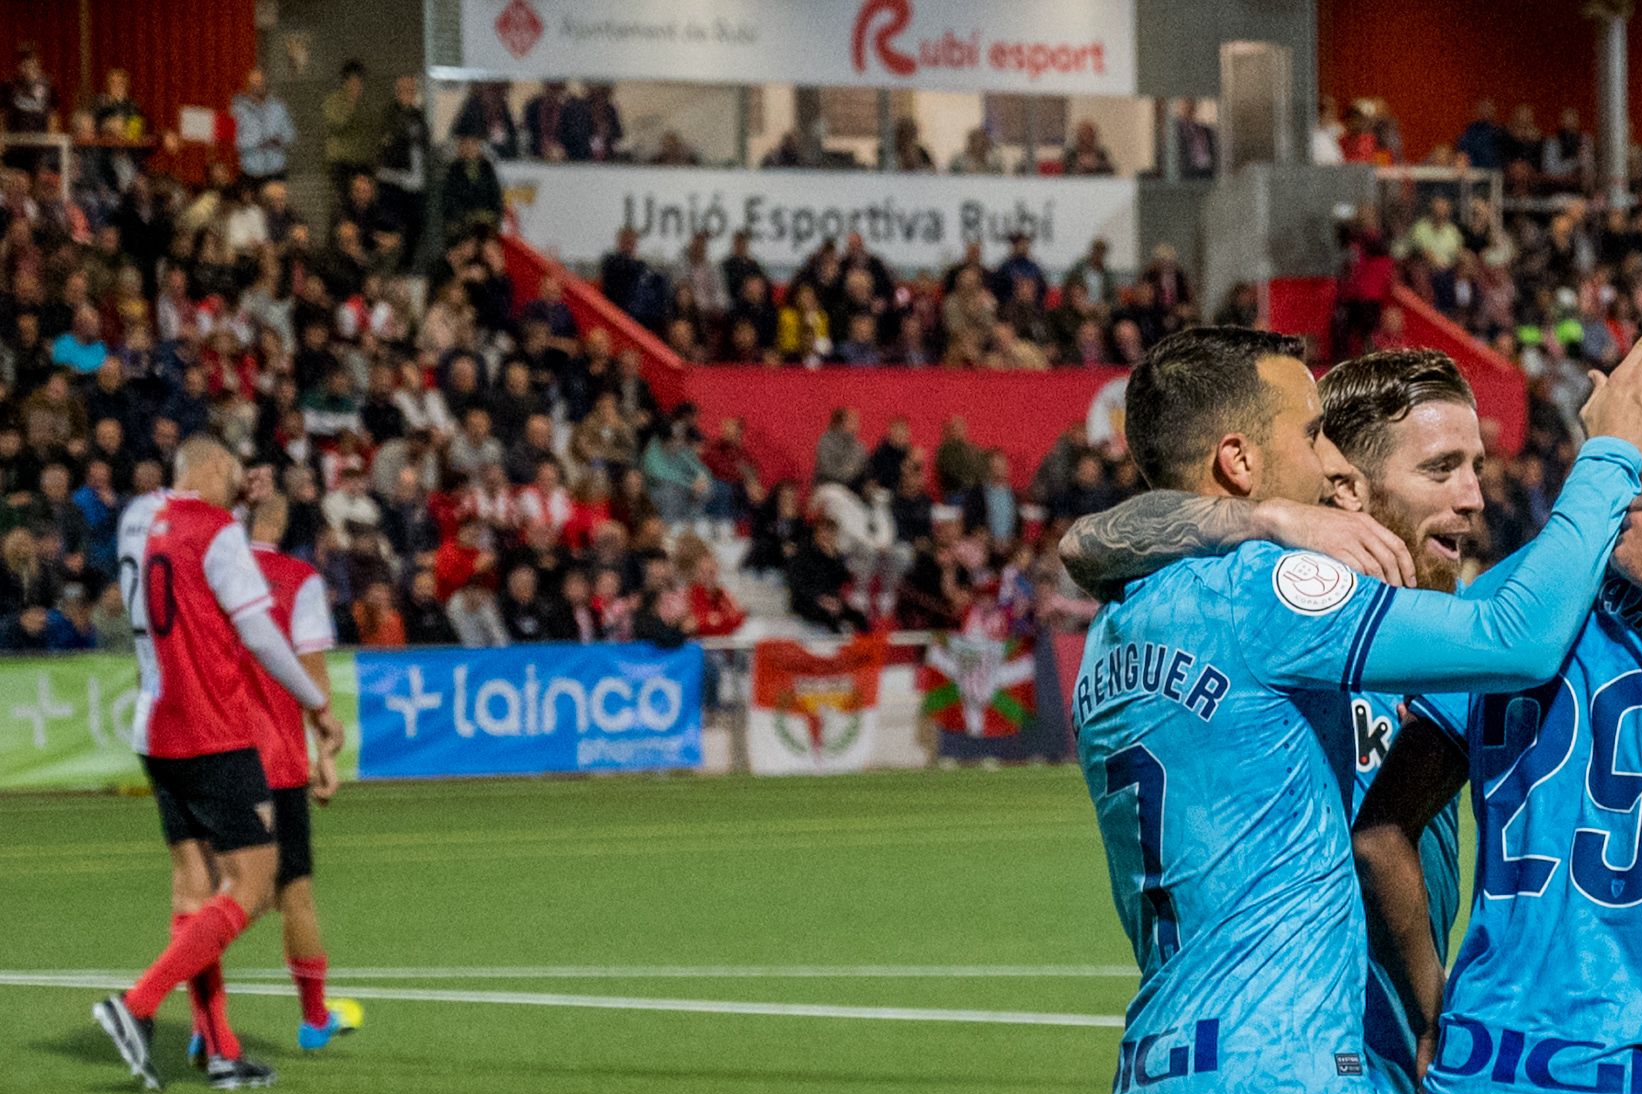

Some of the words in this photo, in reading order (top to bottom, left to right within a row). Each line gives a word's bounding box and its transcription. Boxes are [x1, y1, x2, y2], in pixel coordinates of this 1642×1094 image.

[987, 38, 1105, 79] esport
[623, 191, 727, 240] Unió
[745, 196, 944, 248] Esportiva
[961, 198, 1055, 246] Rubí
[453, 663, 683, 738] lainco
[1120, 1018, 1209, 1094] IGI
